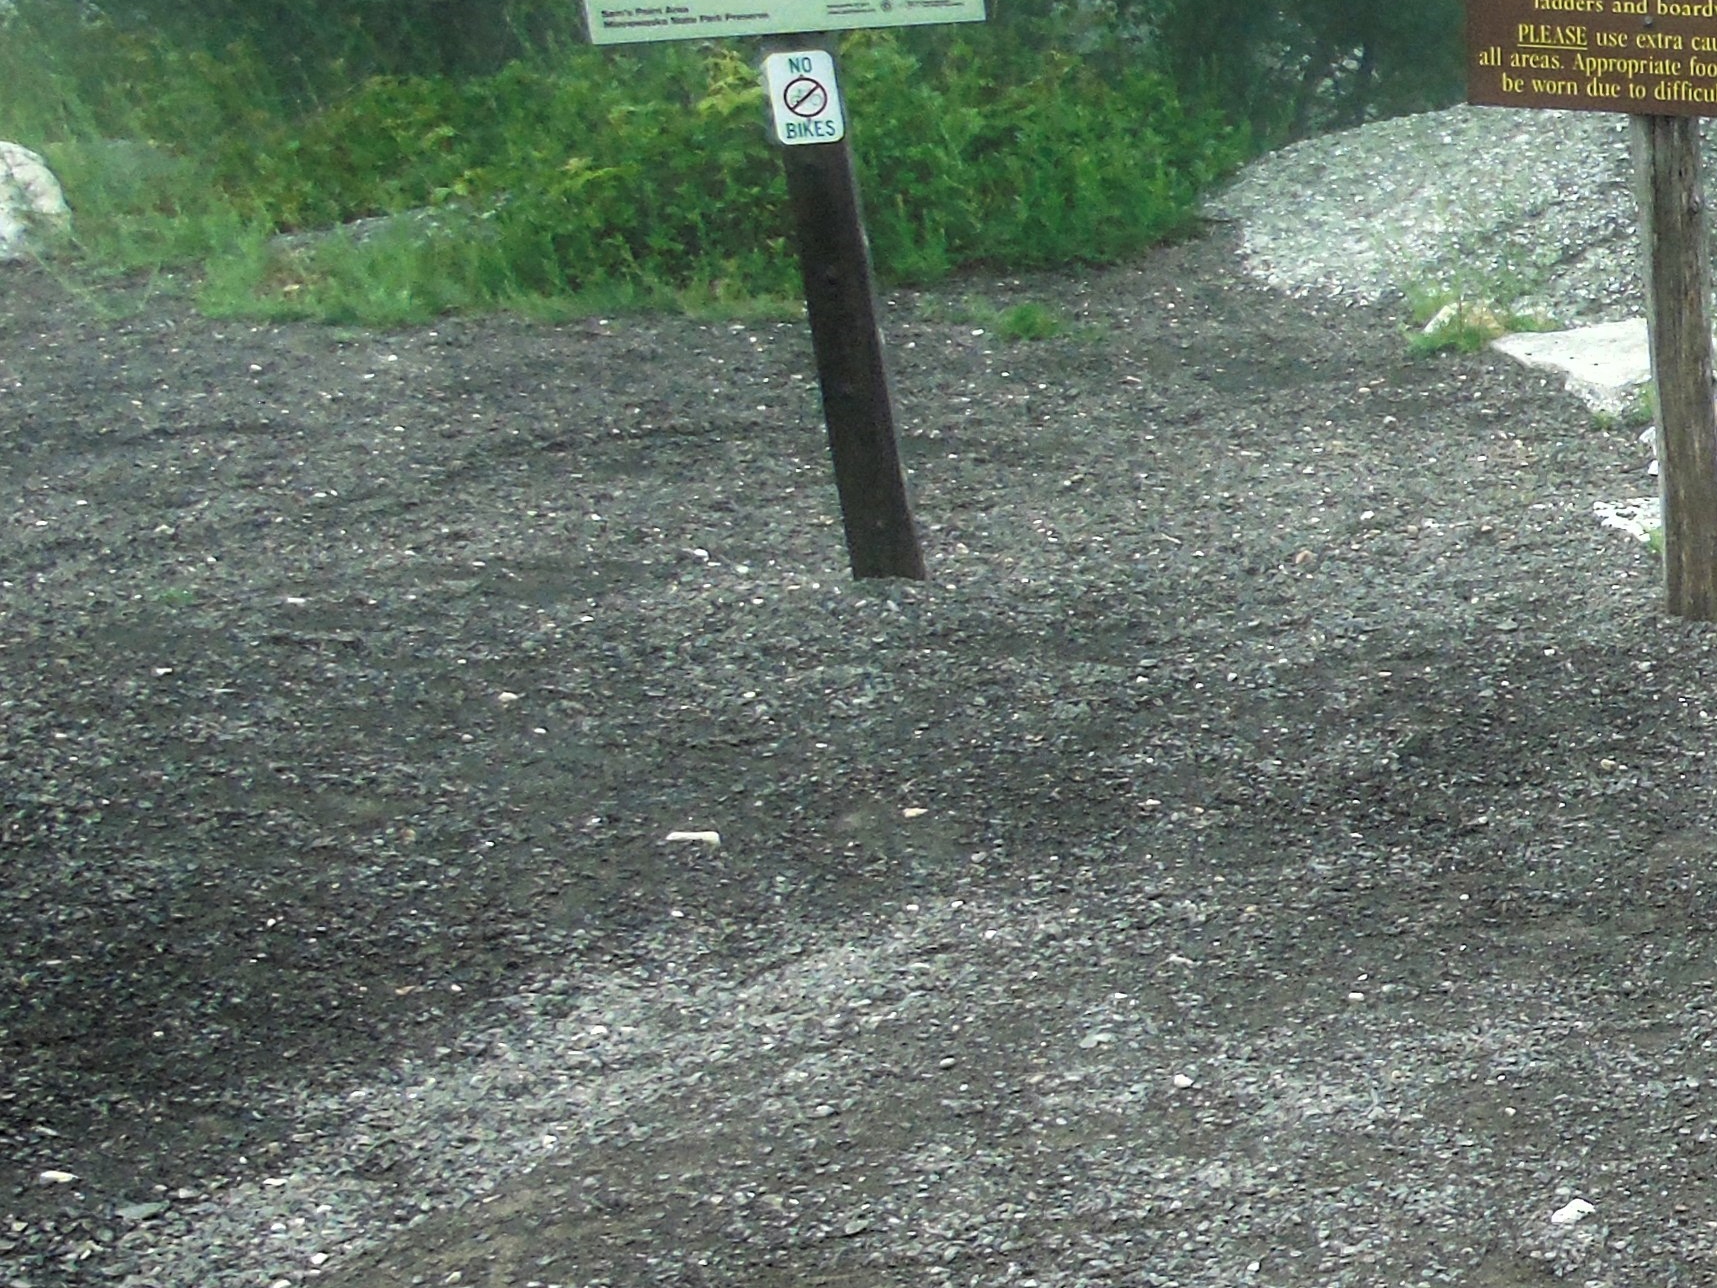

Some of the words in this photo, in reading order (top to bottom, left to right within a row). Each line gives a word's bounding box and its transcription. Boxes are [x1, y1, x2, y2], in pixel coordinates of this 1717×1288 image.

[1517, 23, 1588, 46] PLEASE
[1596, 30, 1628, 48] use
[1635, 32, 1683, 51] extra
[788, 56, 812, 73] NO
[1478, 46, 1501, 67] all
[1510, 52, 1565, 71] areas.
[1573, 51, 1681, 79] Appropriate
[1502, 72, 1524, 94] be
[1531, 79, 1578, 96] worn
[1586, 78, 1621, 99] due
[1628, 82, 1647, 100] to
[785, 120, 836, 139] BIKES
